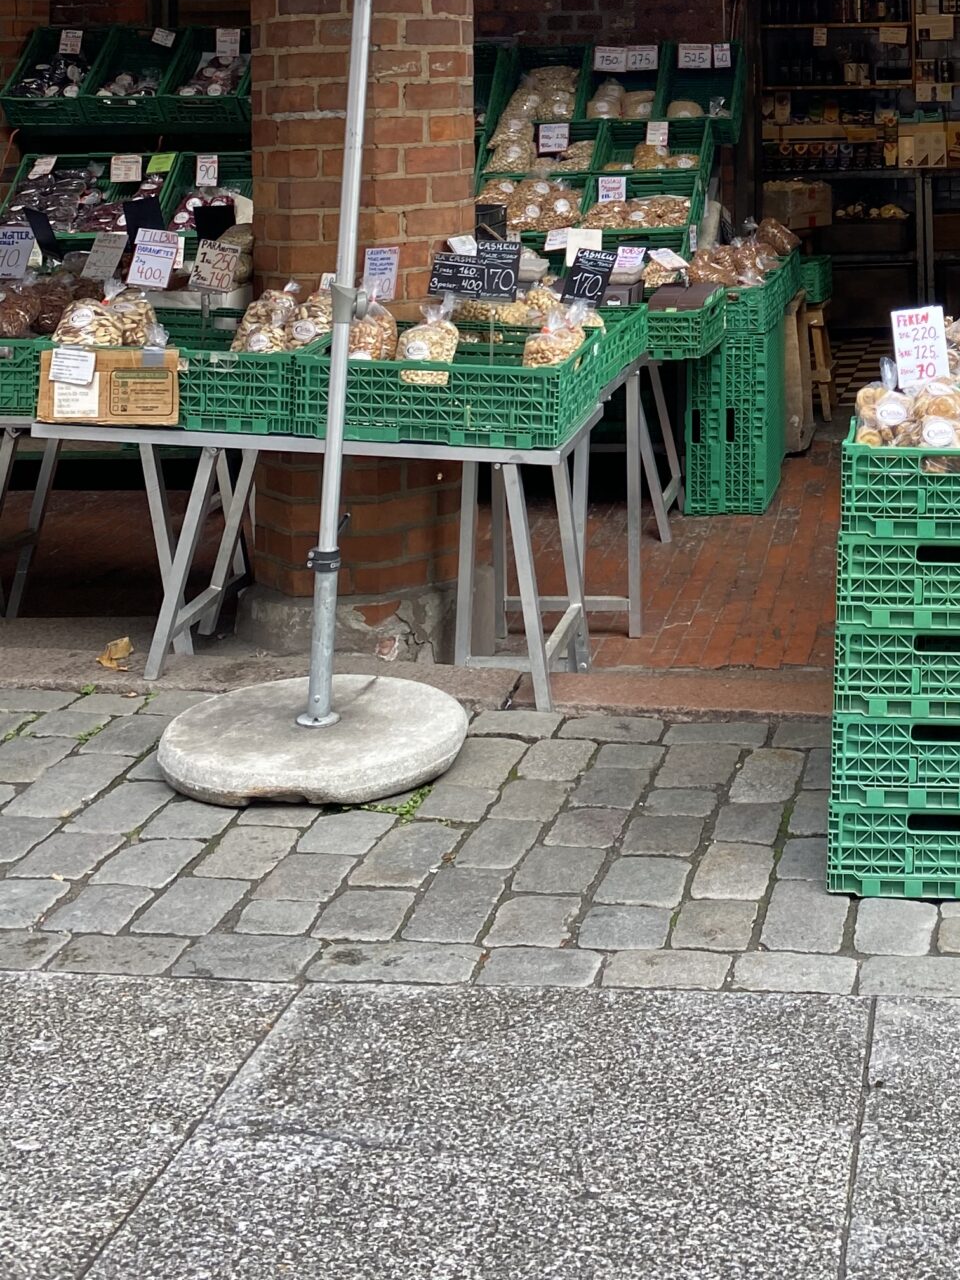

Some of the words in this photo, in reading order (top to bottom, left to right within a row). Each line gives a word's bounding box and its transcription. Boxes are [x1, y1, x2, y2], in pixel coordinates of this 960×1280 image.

[141, 229, 178, 243] TILBUD
[478, 241, 520, 251] CASHEW
[577, 248, 617, 261] CASHEW
